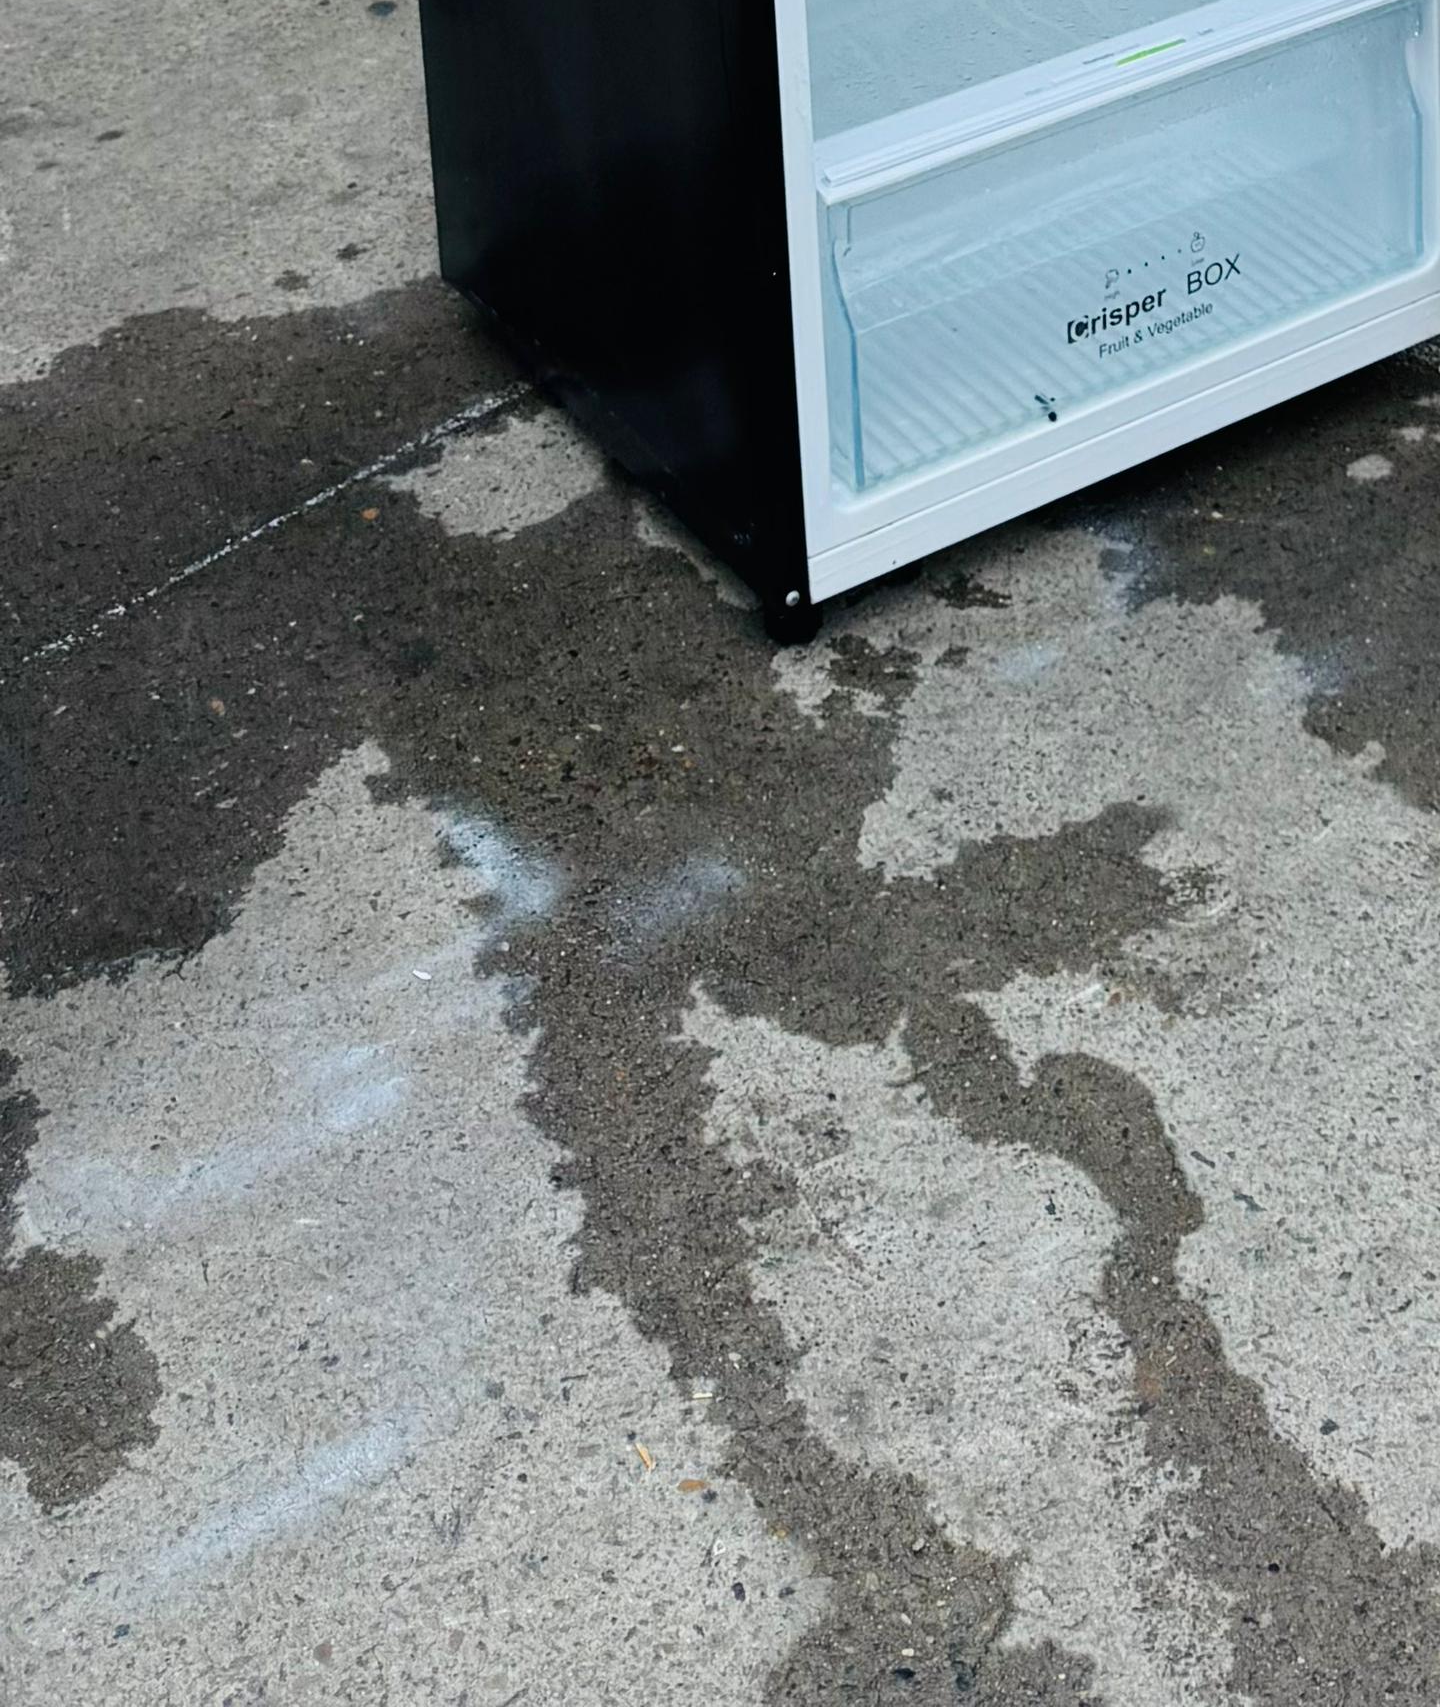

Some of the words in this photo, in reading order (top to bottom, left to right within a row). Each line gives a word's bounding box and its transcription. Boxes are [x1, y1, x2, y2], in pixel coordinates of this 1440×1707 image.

[1187, 253, 1242, 295] BOX
[1098, 337, 1130, 358] Fruit
[1133, 329, 1143, 344] &
[1147, 302, 1214, 337] Vegetable
